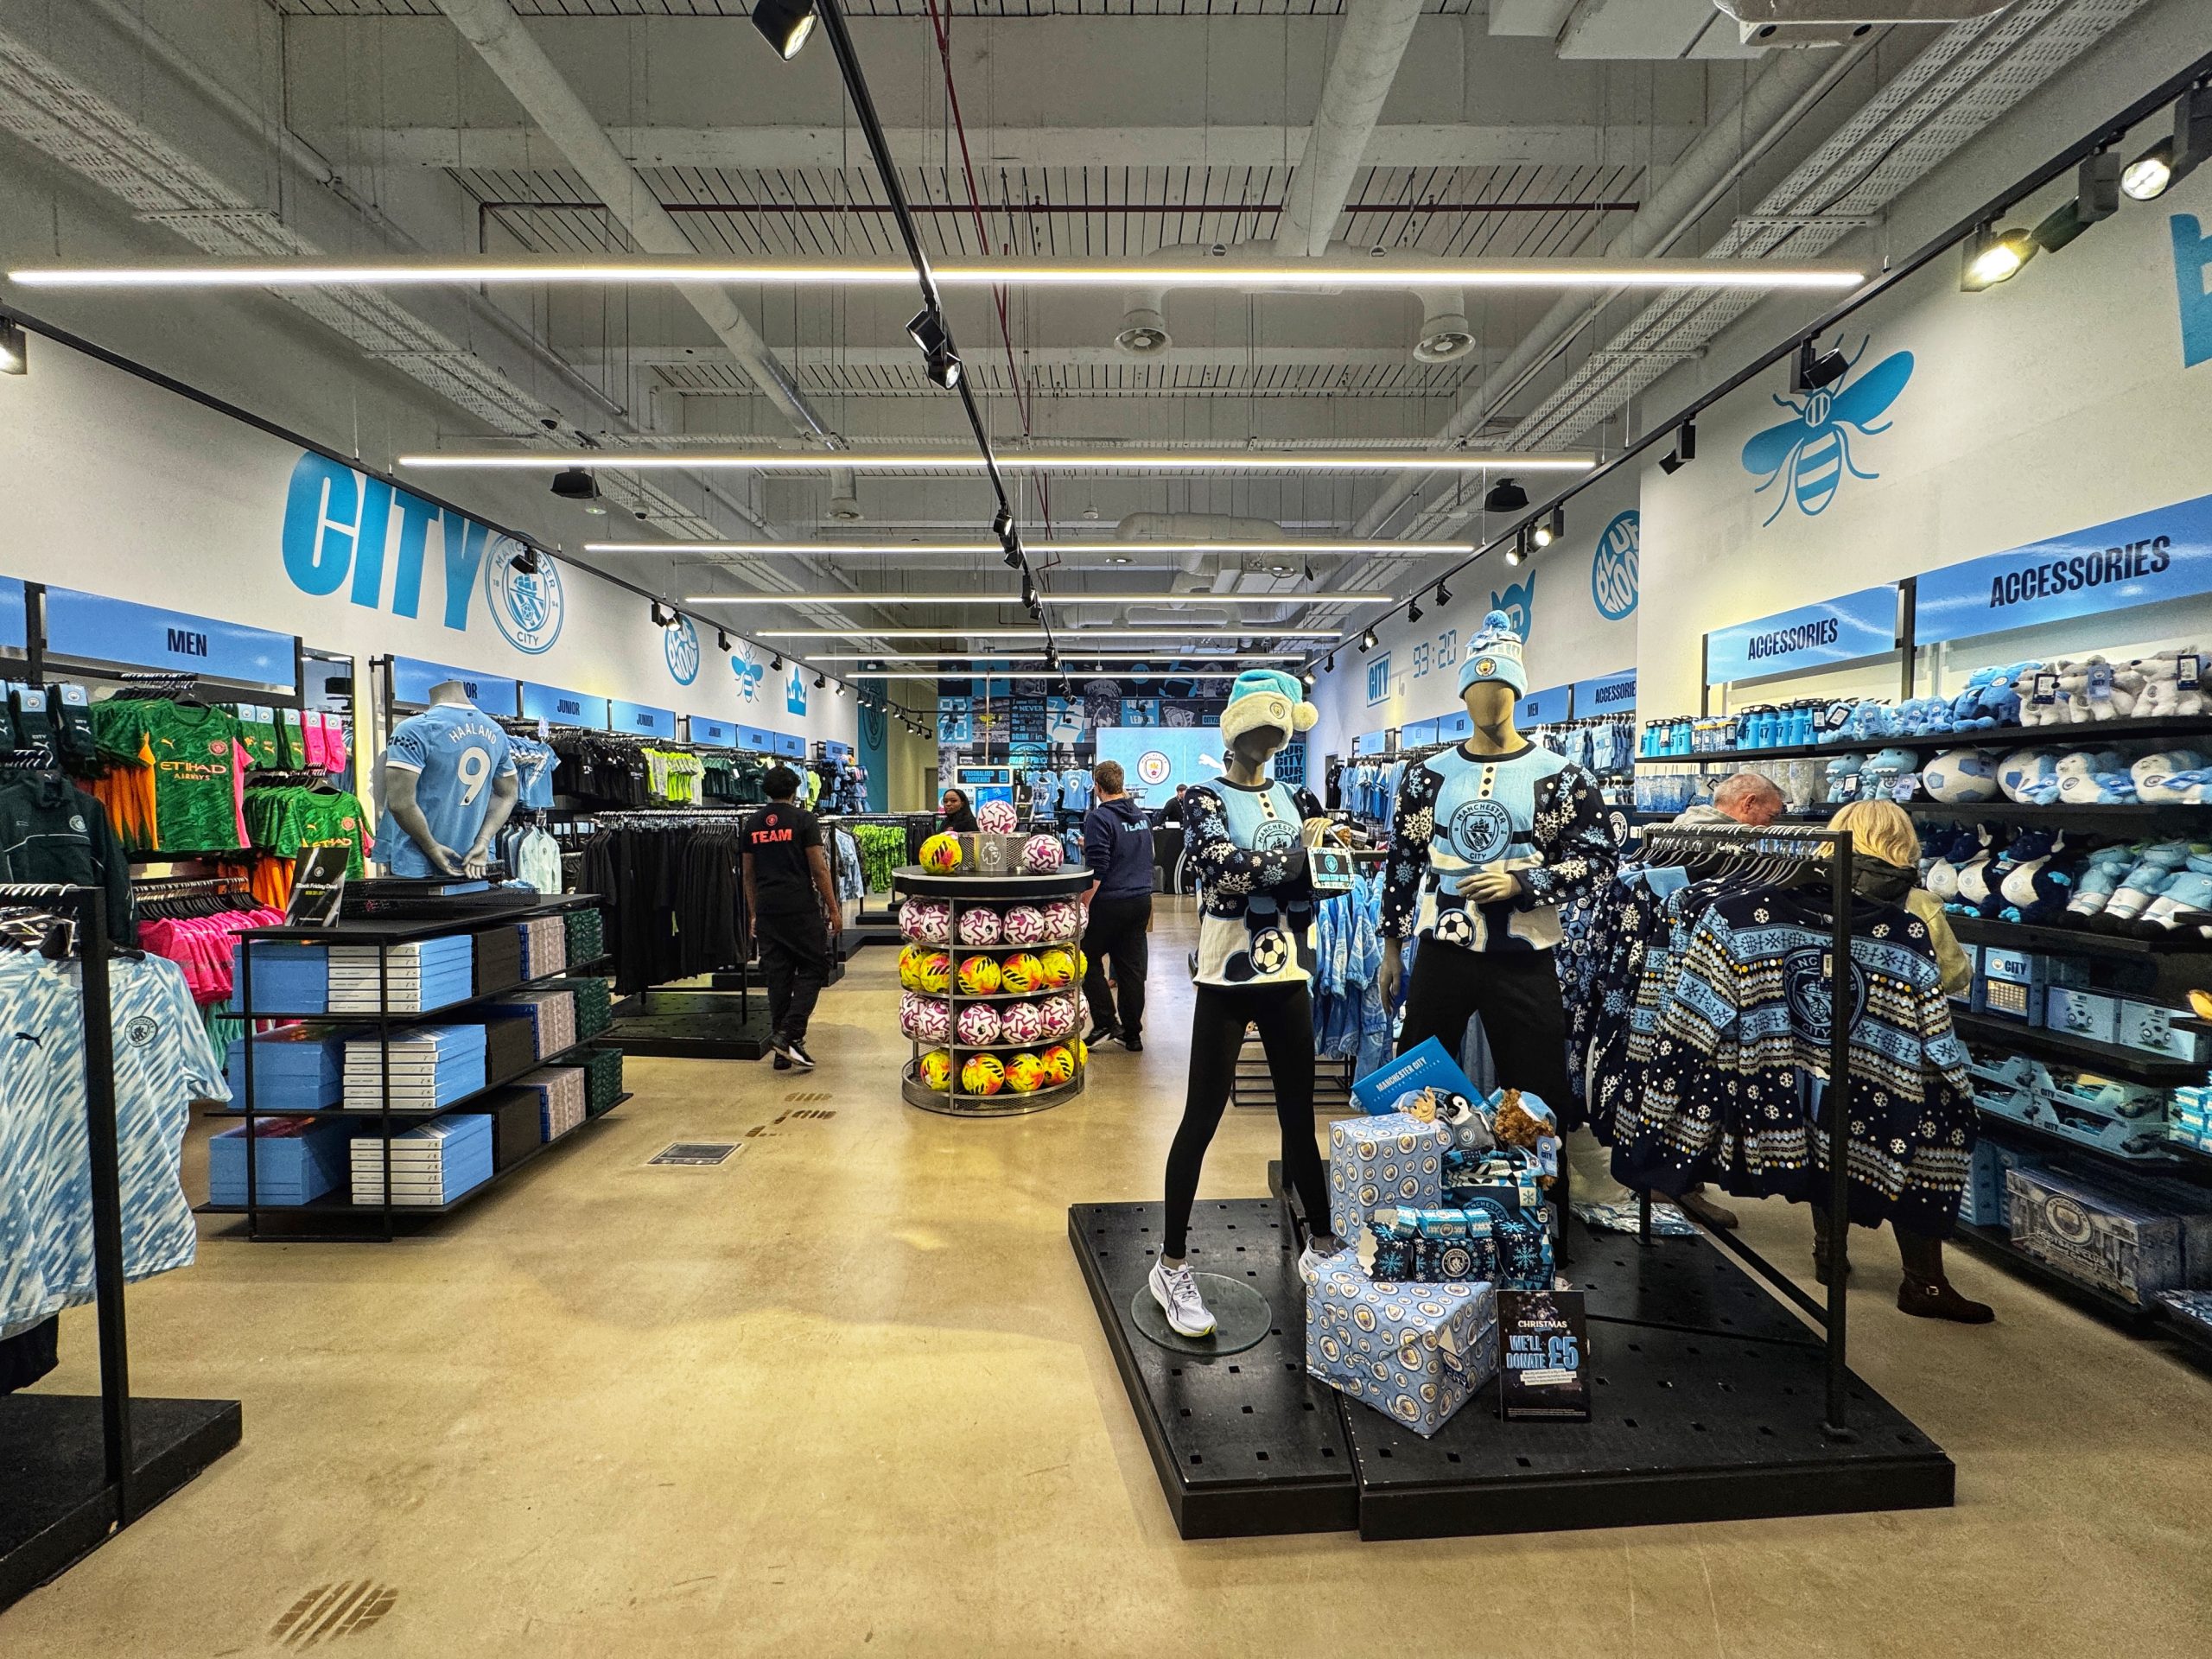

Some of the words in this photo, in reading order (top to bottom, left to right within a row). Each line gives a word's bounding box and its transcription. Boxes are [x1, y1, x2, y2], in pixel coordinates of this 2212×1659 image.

[282, 451, 490, 632] CITY
[495, 542, 556, 588] MANCSTER
[1989, 534, 2171, 608] ACCESSORIES
[1604, 550, 1639, 613] MOO
[167, 627, 207, 658] MEN
[517, 631, 539, 646] CITY
[1747, 617, 1839, 661] ACCESSORIES
[1369, 658, 1389, 702] CITY
[1595, 680, 1637, 704] ACCESSORIE
[556, 699, 581, 716] JUNIOR
[1527, 702, 1539, 718] MEN
[637, 713, 654, 728] JUNIOR
[448, 722, 498, 745] HAALAND
[1759, 728, 1770, 739] 47
[160, 760, 226, 774] ETIHAD
[1274, 753, 1304, 766] CITY
[173, 772, 211, 781] AIRWAYS
[457, 746, 492, 807] 9
[1274, 766, 1304, 778] OUR
[1456, 804, 1507, 824] MANCHESTER
[1122, 819, 1148, 832] TEAM
[751, 829, 792, 844] TEAM
[2004, 960, 2027, 976] CITY
[1802, 1023, 1831, 1038] CITY
[1376, 1064, 1415, 1092] MANCHESTER
[1411, 1056, 1427, 1070] CITY
[2040, 1087, 2055, 1098] CITY
[2044, 1122, 2059, 1133] CITY
[1471, 1201, 1505, 1220] NCHESTER
[1509, 1335, 1542, 1351] WE'LL
[1506, 1352, 1547, 1369] DONATE
[1548, 1335, 1580, 1370] £5
